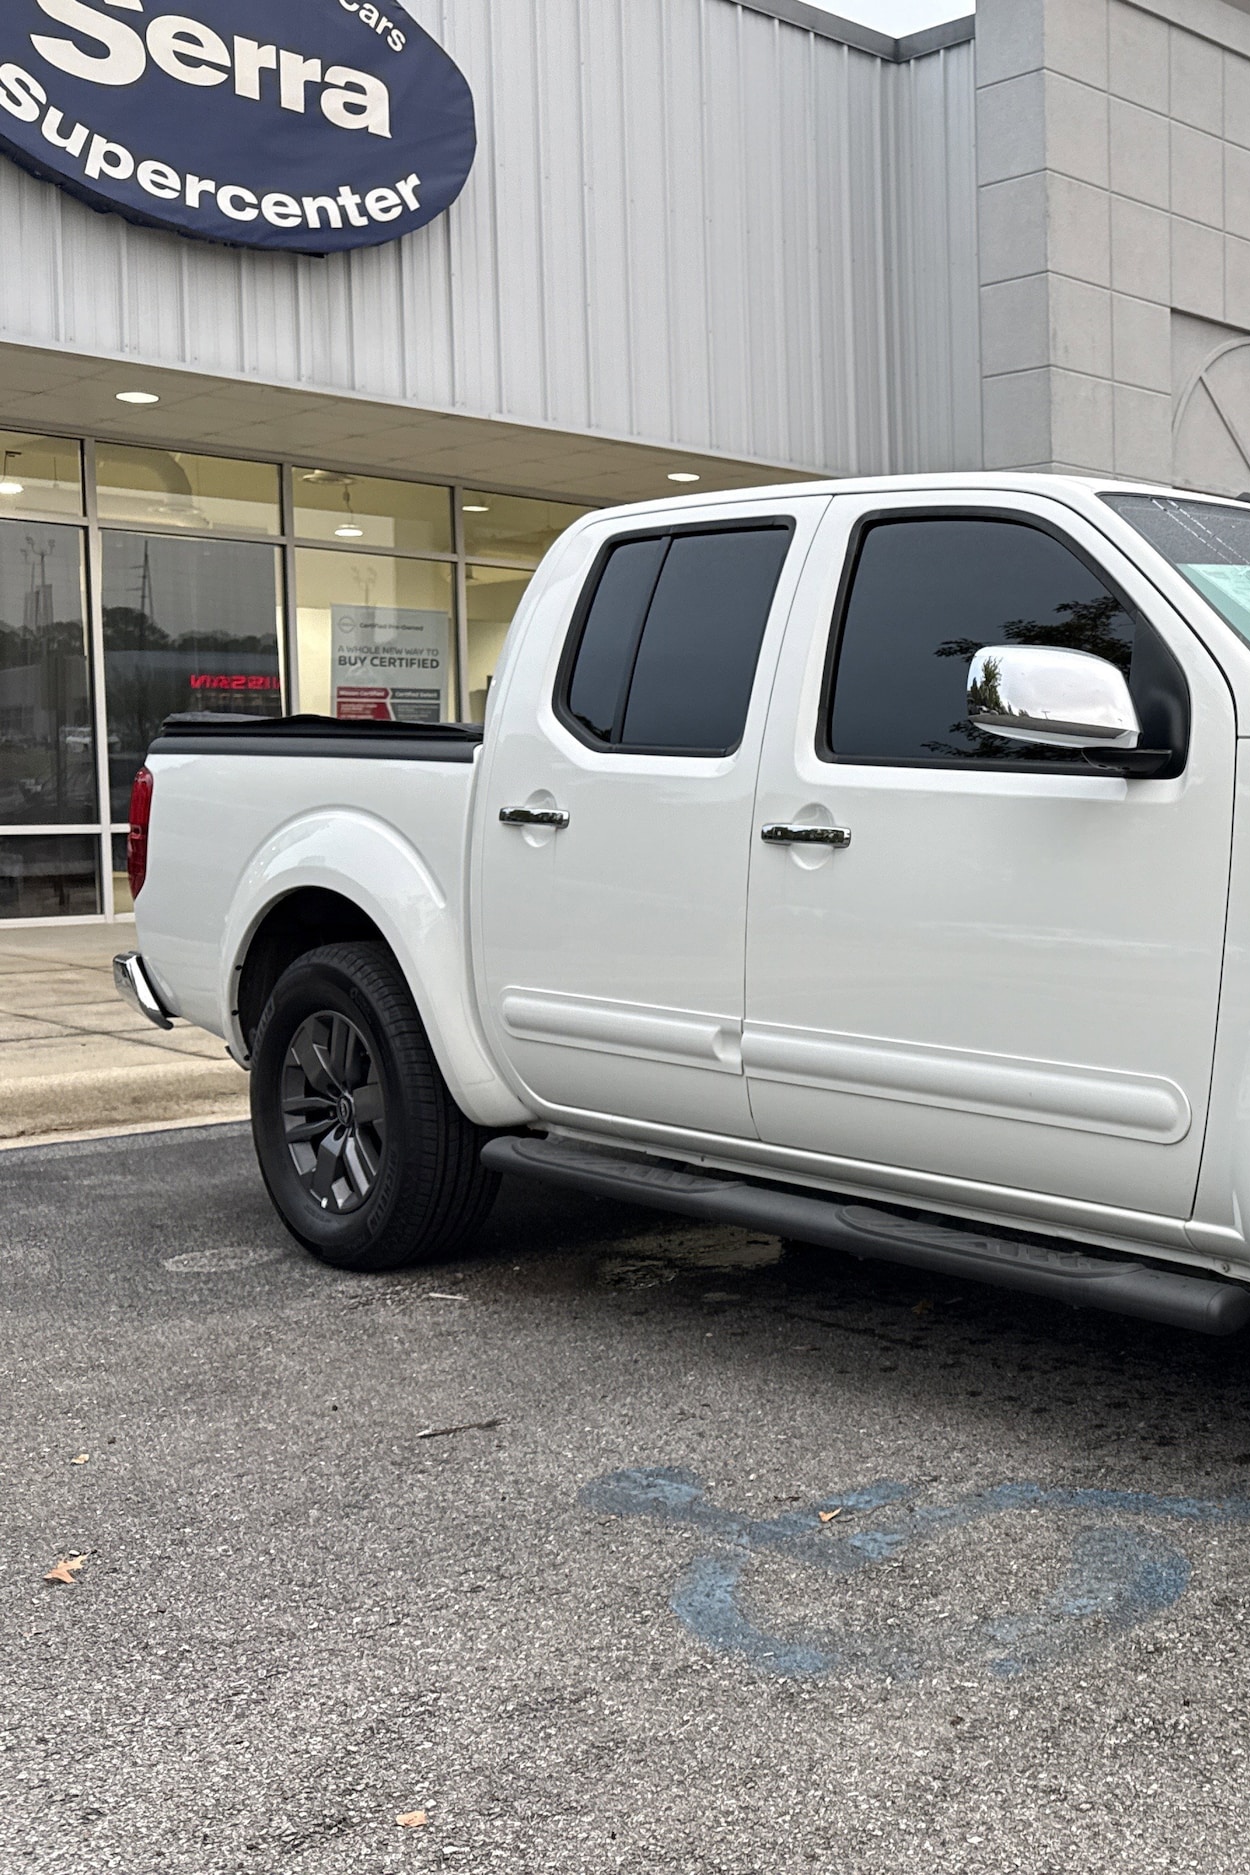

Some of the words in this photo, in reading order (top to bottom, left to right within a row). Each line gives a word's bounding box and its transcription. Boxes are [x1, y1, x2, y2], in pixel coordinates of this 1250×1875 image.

[30, 0, 392, 139] Serra
[0, 63, 422, 229] Supercenter
[338, 645, 345, 653] A
[346, 645, 380, 655] WHOLE
[382, 647, 404, 655] NEW
[405, 648, 424, 656] WAY
[426, 648, 440, 657] TO
[338, 655, 368, 667] BUY
[370, 656, 440, 669] CERTIFIED
